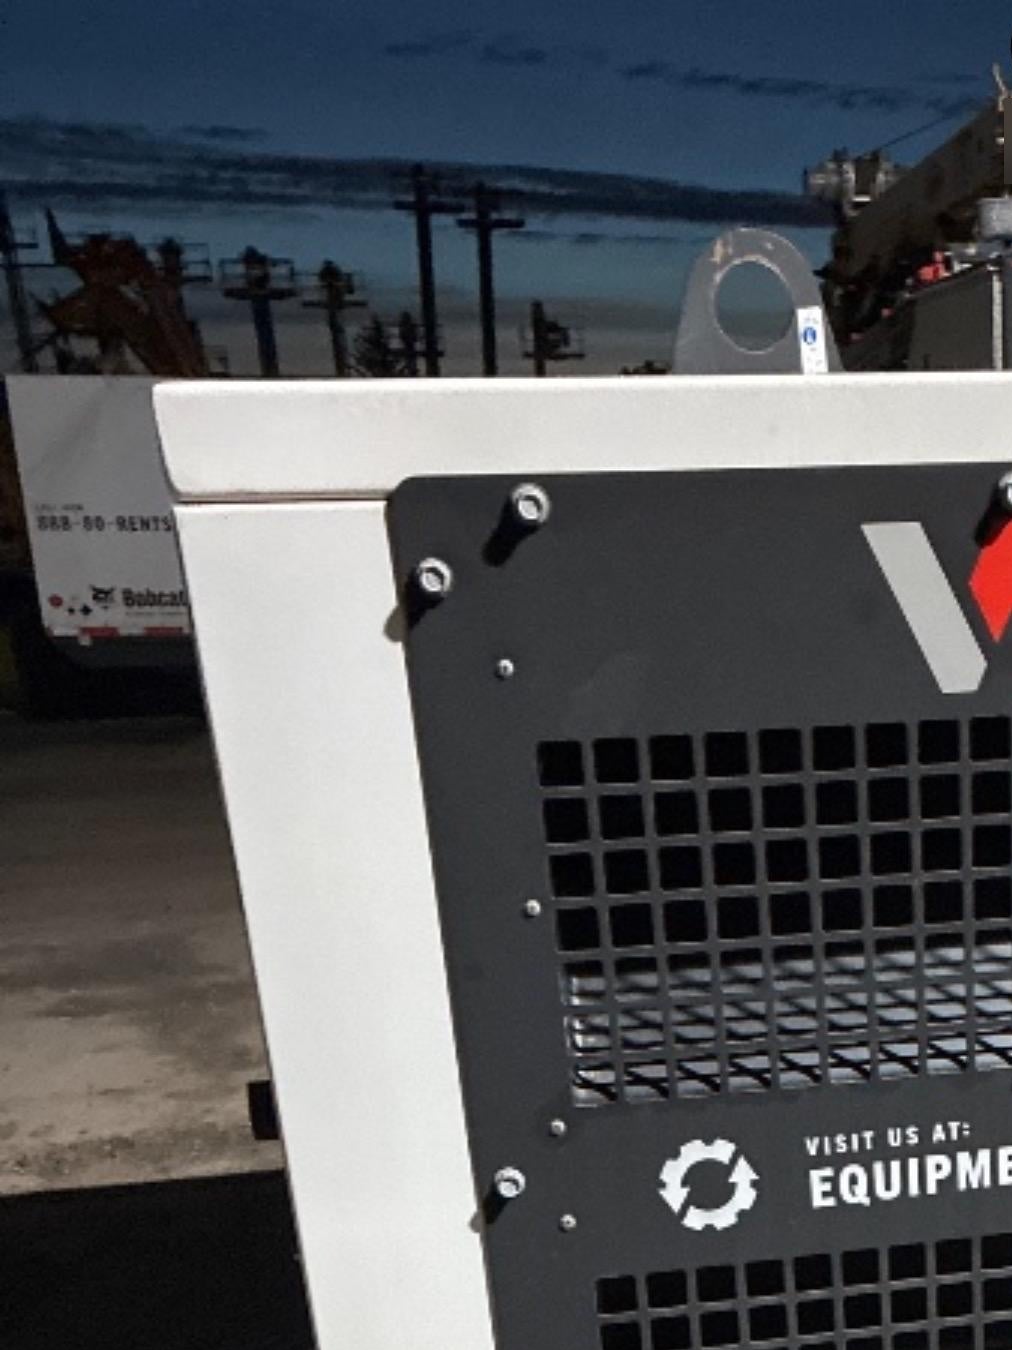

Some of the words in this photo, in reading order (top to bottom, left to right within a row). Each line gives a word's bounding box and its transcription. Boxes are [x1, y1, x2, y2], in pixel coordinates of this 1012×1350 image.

[804, 1130, 875, 1157] VISIT
[887, 1125, 919, 1148] US
[932, 1120, 971, 1144] AT:
